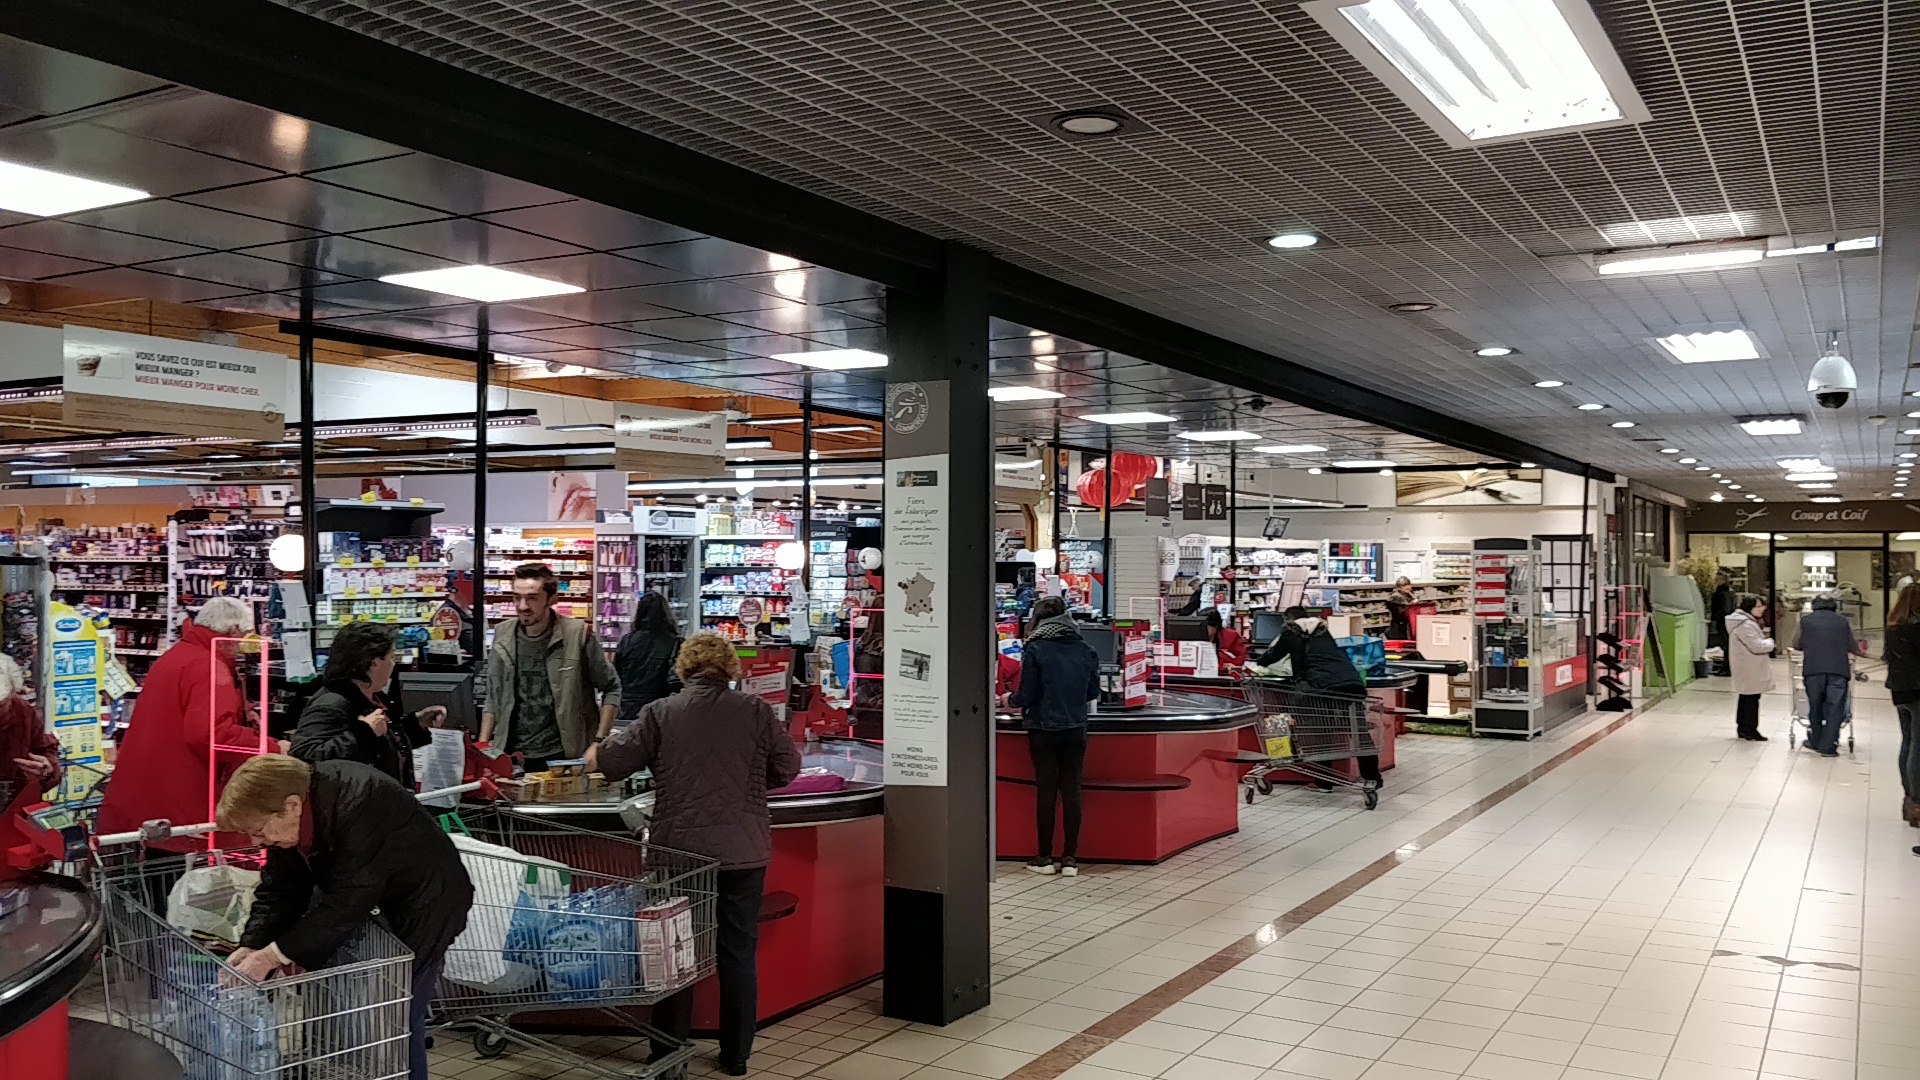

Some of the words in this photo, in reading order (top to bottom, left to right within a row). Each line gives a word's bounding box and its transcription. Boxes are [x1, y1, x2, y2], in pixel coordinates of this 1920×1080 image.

[135, 351, 155, 361] VOUS
[157, 353, 179, 364] SAVEZ
[180, 356, 190, 366] CE
[206, 360, 217, 369] EST
[219, 362, 242, 372] MIEUX
[135, 363, 160, 373] MIEUX
[162, 366, 194, 377] MANGER
[135, 375, 160, 385] MIEUX
[161, 378, 194, 389] MANGER
[195, 381, 215, 391] POUR
[217, 384, 240, 394] MOINS
[1791, 509, 1824, 522] Coup
[1825, 510, 1839, 520] et
[446, 548, 456, 562] 6
